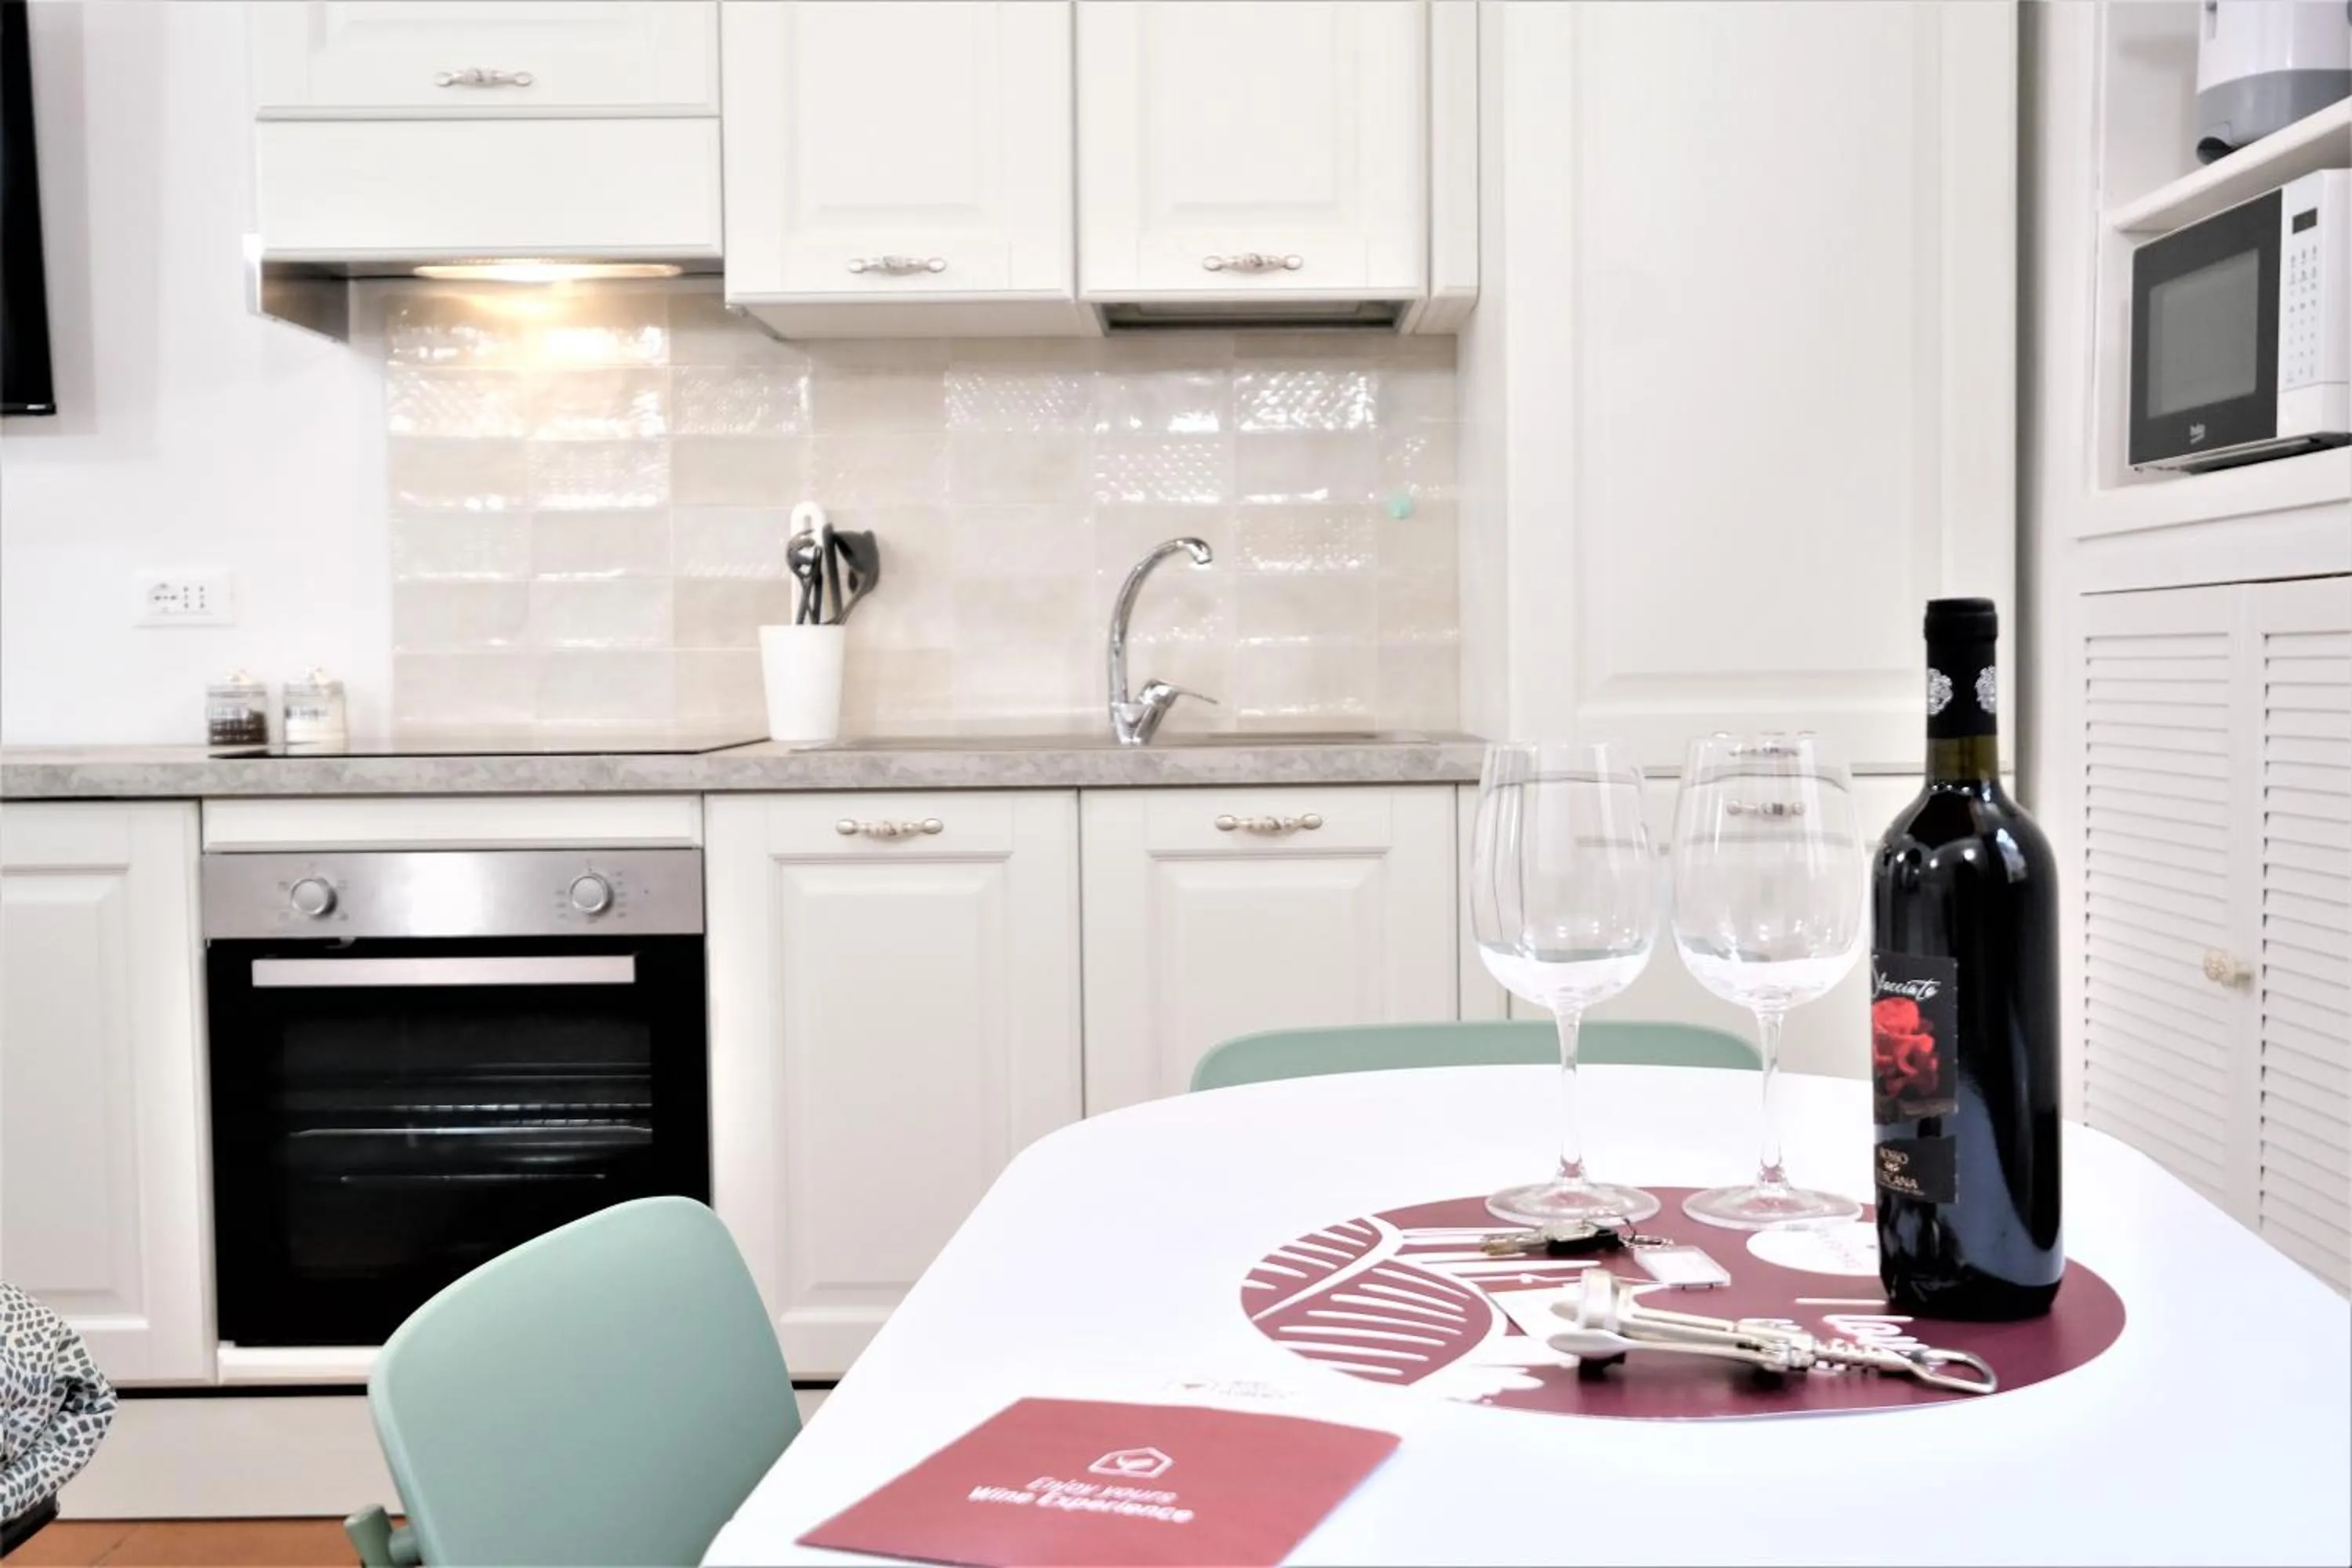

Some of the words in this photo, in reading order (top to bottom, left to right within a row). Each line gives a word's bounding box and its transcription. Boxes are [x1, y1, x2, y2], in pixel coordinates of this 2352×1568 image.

[967, 1486, 1036, 1504] Wine
[1036, 1490, 1194, 1523] Experience
[1025, 1476, 1101, 1497] Enjoy
[1094, 1486, 1178, 1505] yours
